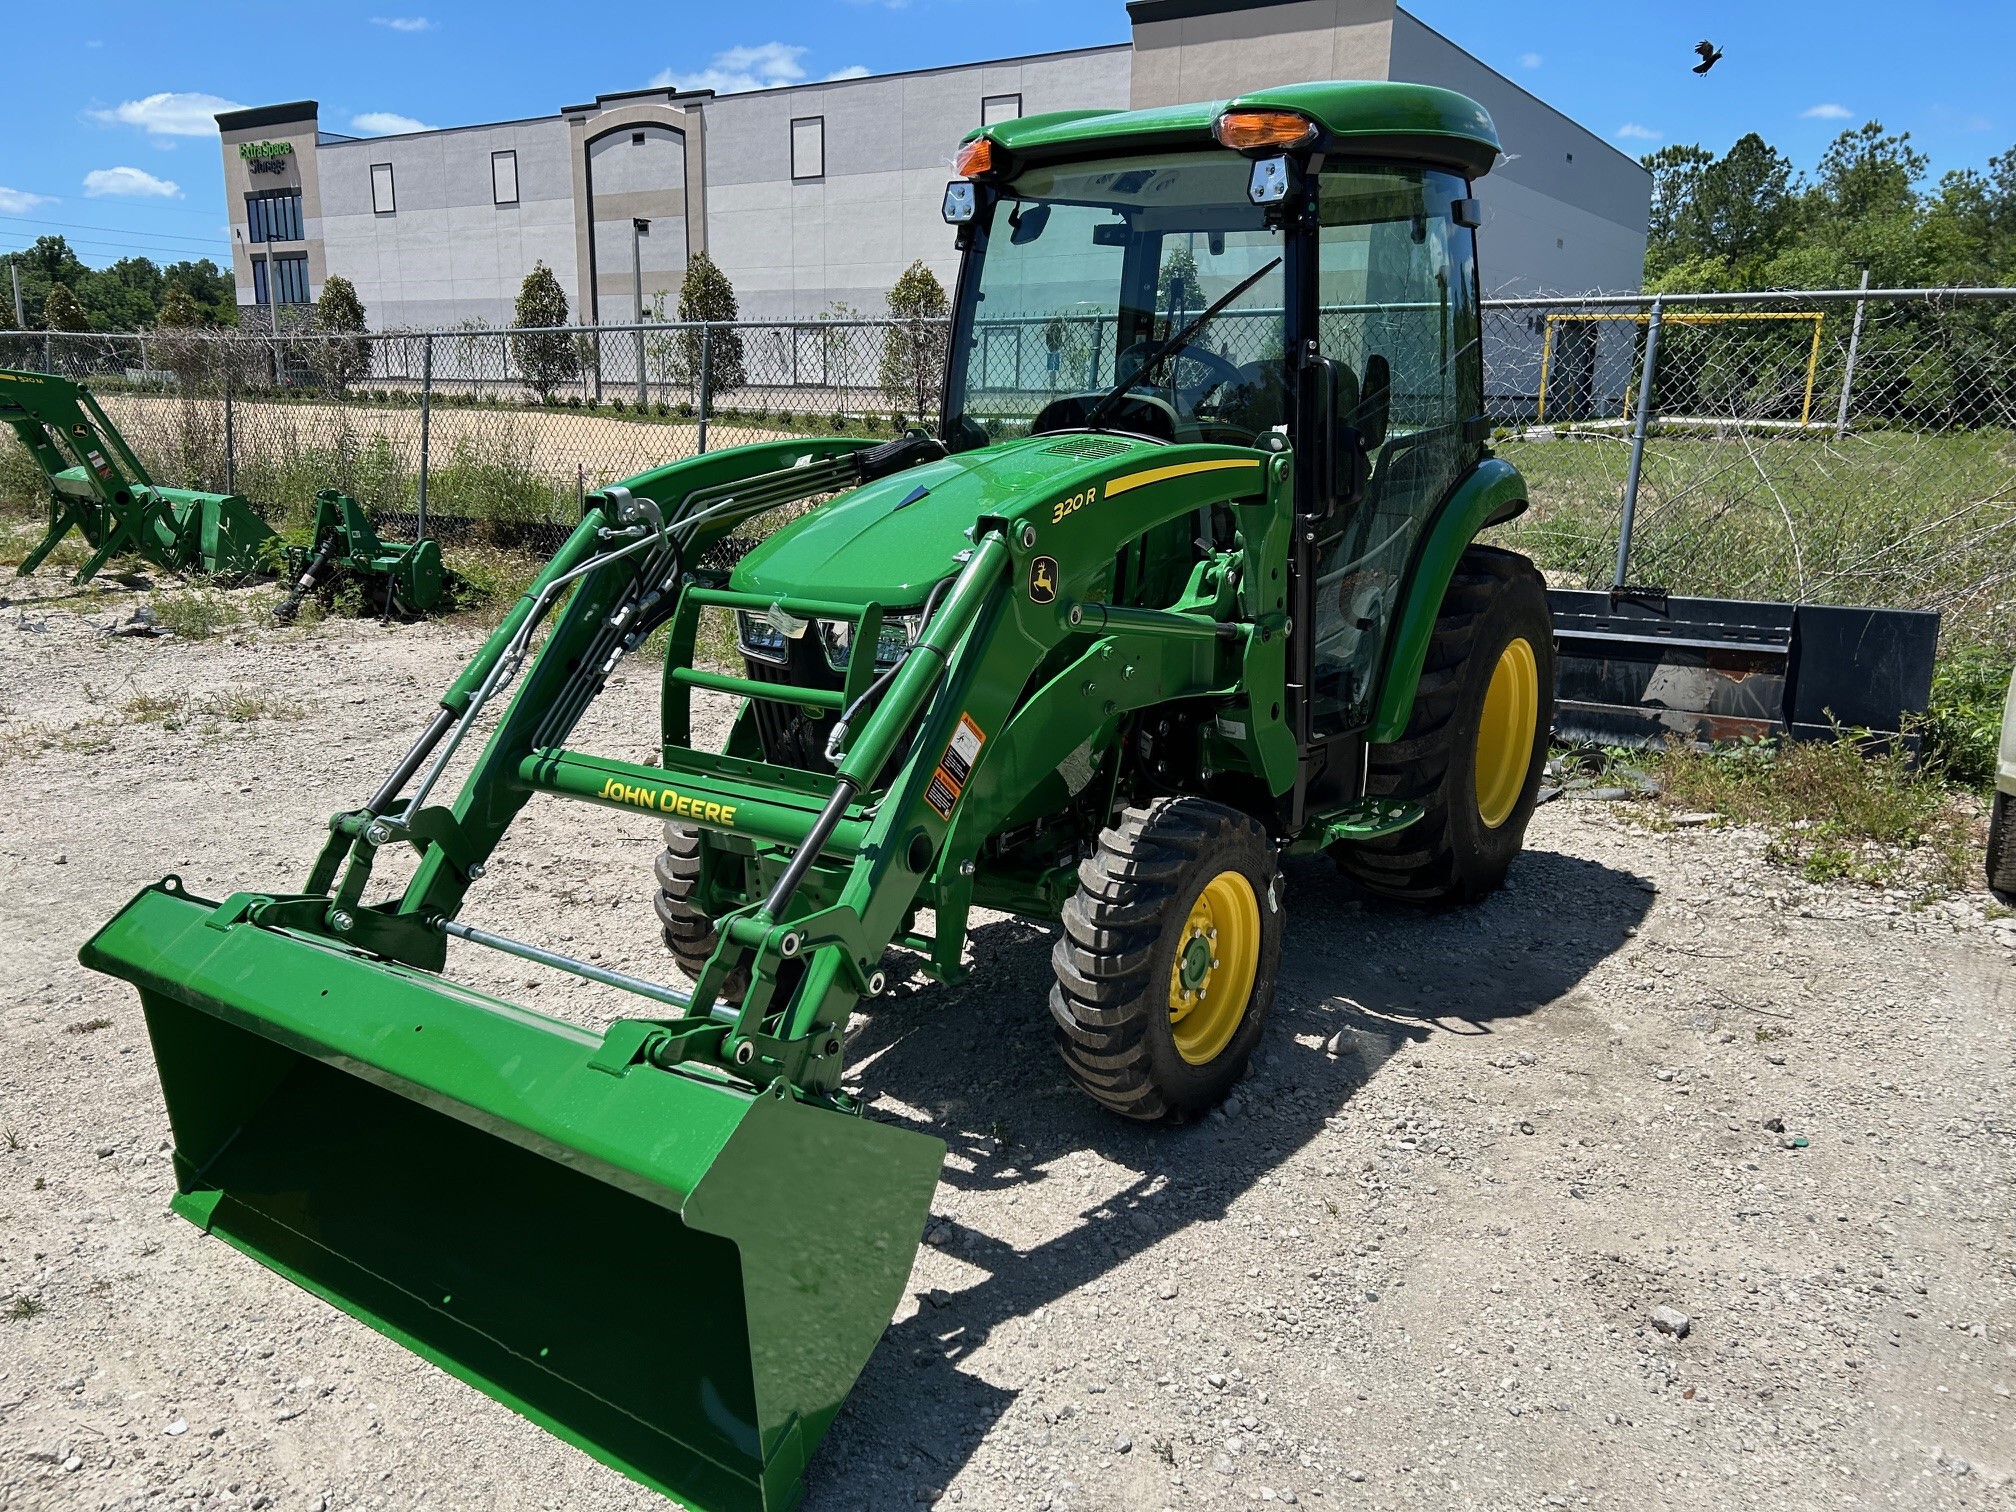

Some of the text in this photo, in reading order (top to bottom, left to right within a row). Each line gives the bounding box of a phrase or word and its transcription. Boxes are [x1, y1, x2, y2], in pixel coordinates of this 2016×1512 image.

[250, 159, 285, 175] Storage
[1052, 487, 1096, 524] 320 R
[598, 777, 737, 827] JOHN DEERE
